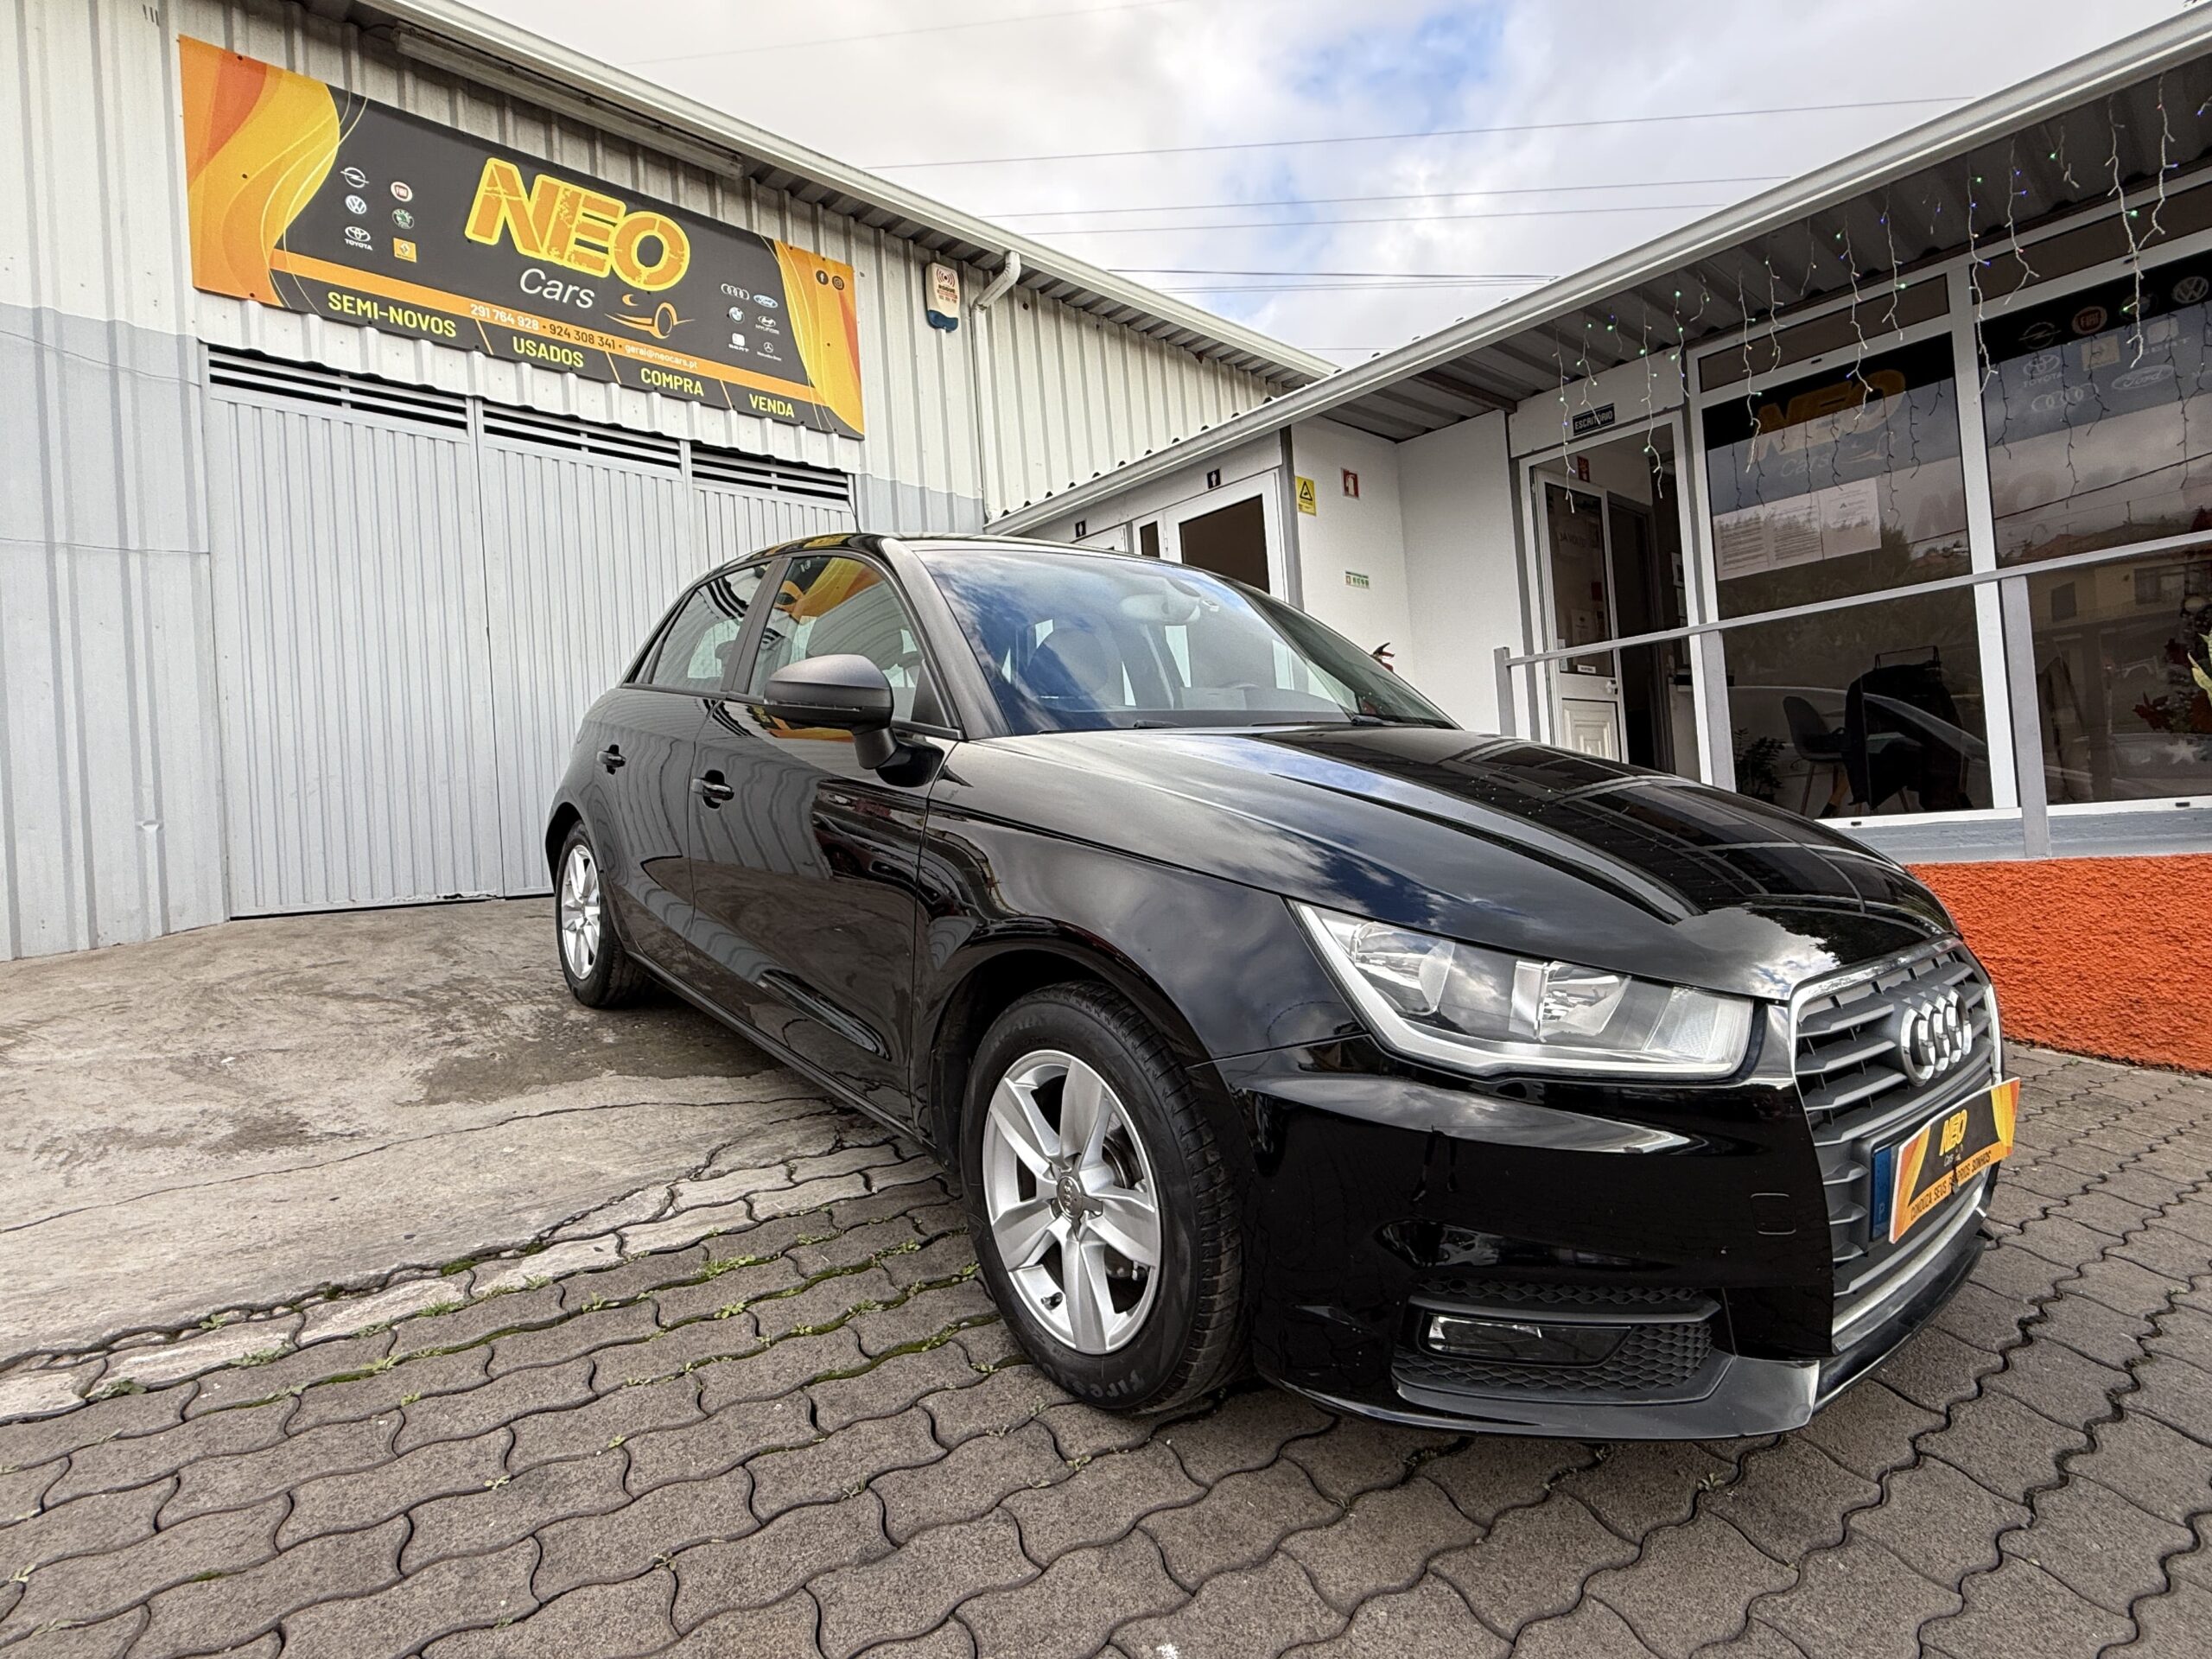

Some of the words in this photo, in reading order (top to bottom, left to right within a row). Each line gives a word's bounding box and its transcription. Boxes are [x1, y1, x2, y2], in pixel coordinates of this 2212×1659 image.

[465, 157, 690, 291] NEO
[345, 238, 373, 251] TOYOTA
[519, 268, 595, 308] Cars
[327, 291, 457, 338] SEMI-NOVOS
[470, 303, 491, 319] 291
[493, 308, 514, 325] 764
[518, 314, 540, 331] 928
[549, 323, 571, 339] 924
[574, 330, 594, 344] 308
[598, 335, 616, 350] 341
[625, 345, 698, 369] geral@neocars.pt
[512, 336, 584, 368] USADOS
[640, 367, 705, 397] COMPRA
[749, 393, 795, 418] VENDA
[1747, 369, 1905, 462] NEO
[1781, 453, 1832, 477] Cars
[1939, 1109, 1967, 1157] NEO
